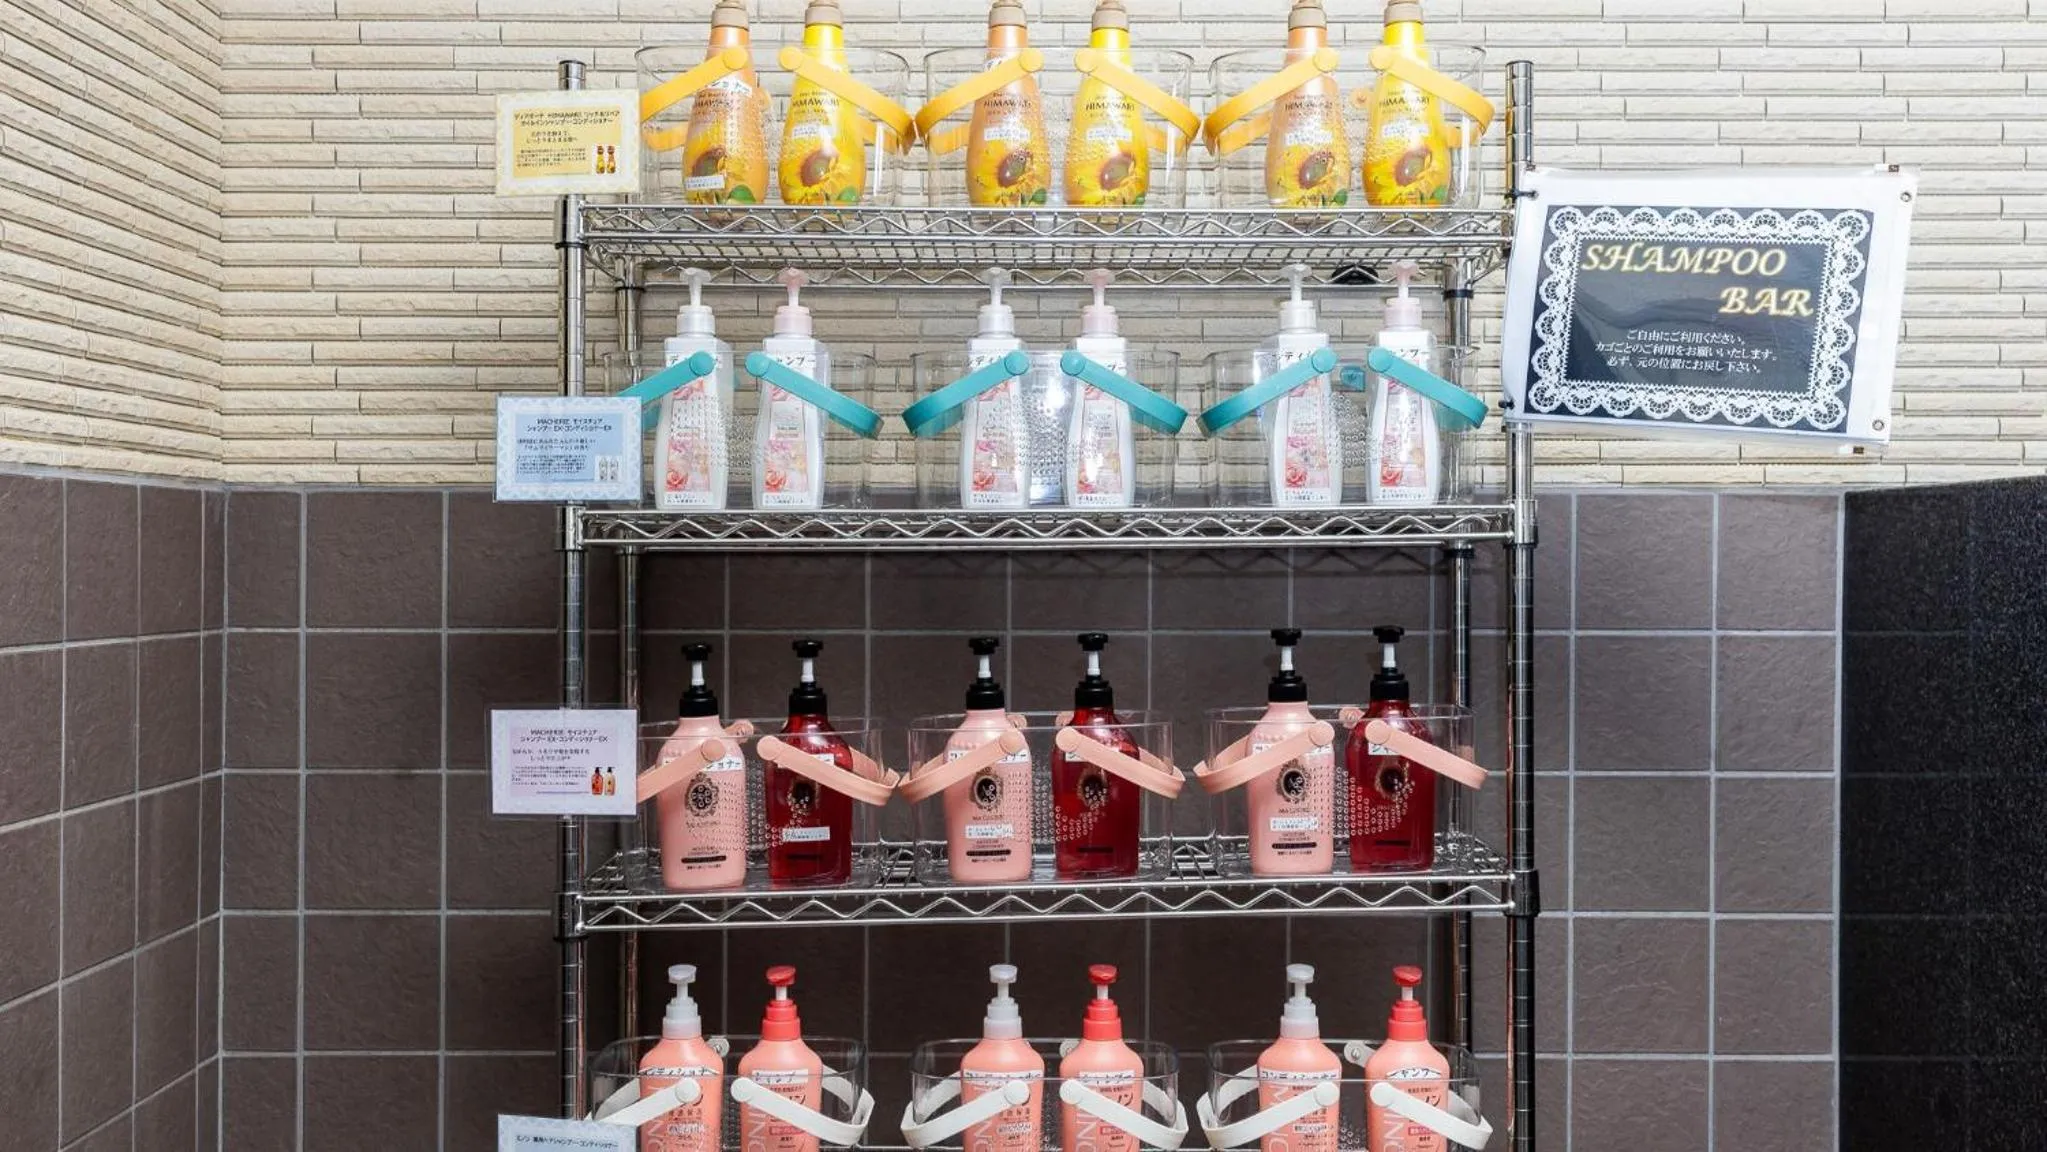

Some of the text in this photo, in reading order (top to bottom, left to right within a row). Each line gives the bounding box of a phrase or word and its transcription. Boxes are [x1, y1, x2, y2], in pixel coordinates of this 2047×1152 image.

[1581, 241, 1788, 277] SHAMPOO
[1718, 286, 1815, 318] BAR
[1626, 328, 1748, 346] ご自由にご利用ください。
[1595, 340, 1779, 362] カゴごとのご利用をお願いいたします。
[1607, 355, 1762, 374] 必ず、元の位置にお戻し下さい。
